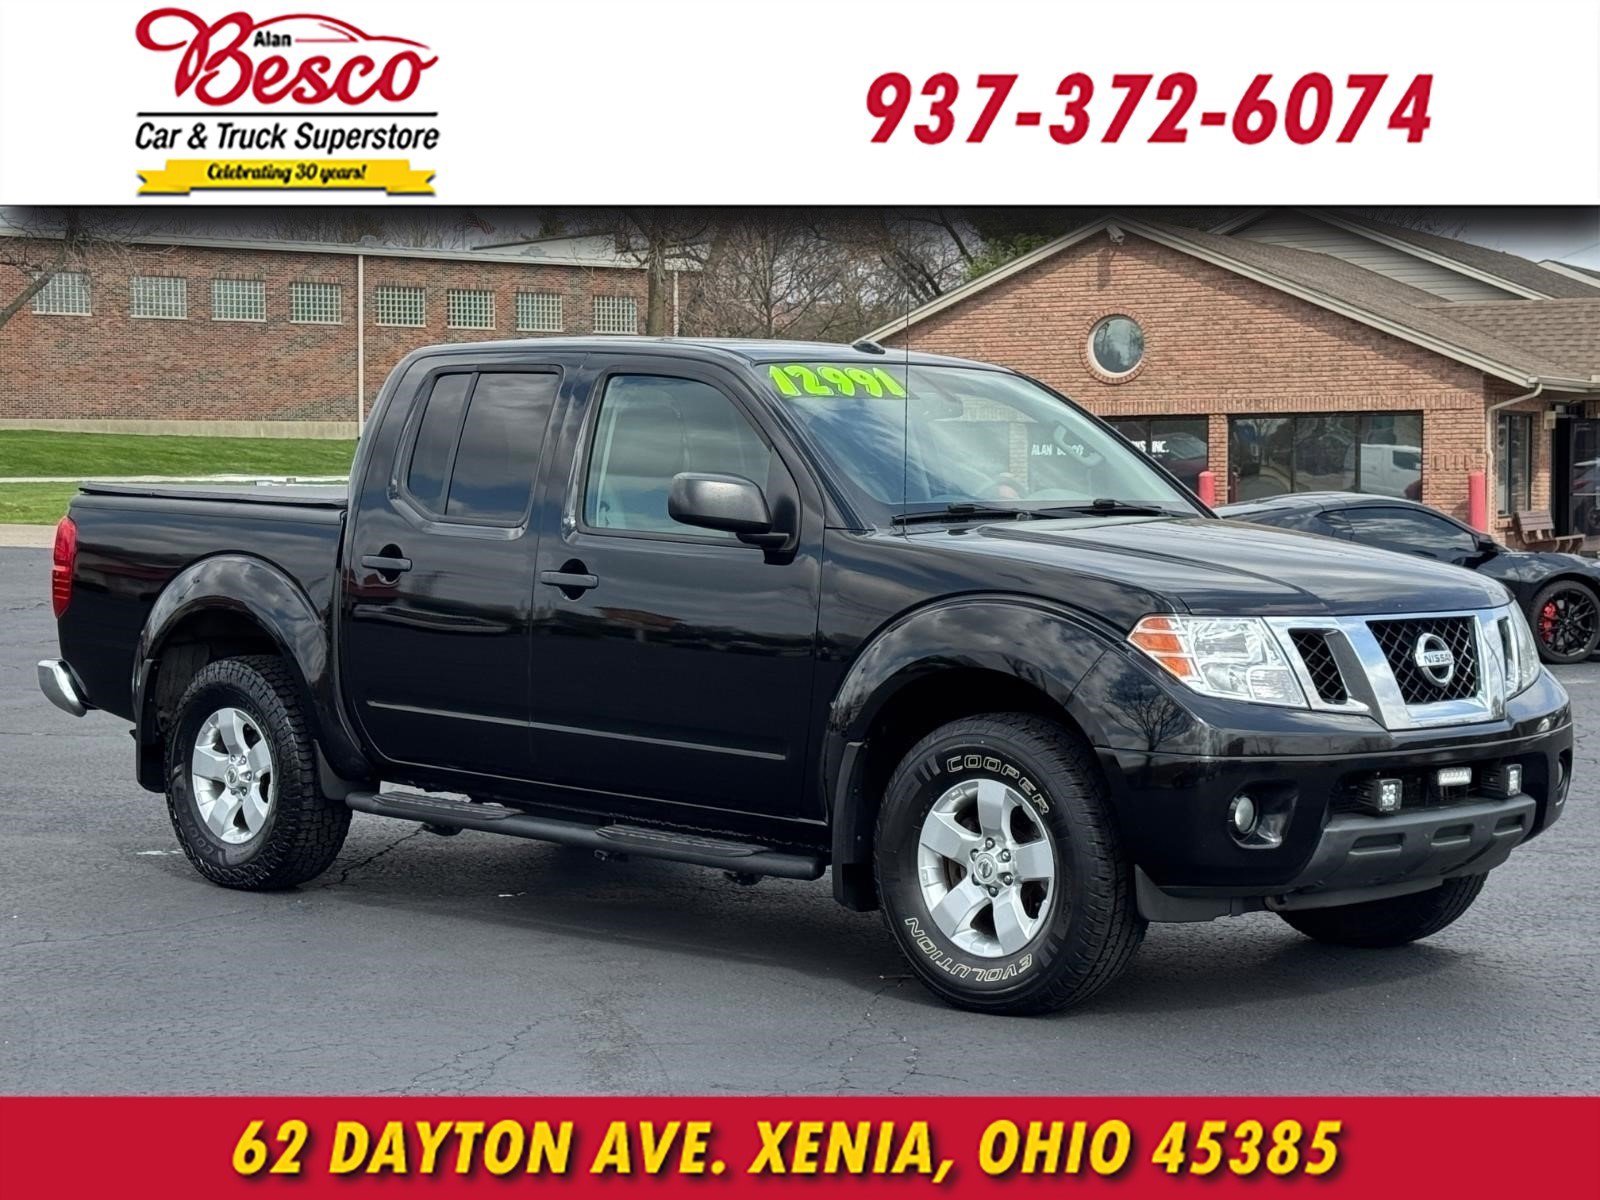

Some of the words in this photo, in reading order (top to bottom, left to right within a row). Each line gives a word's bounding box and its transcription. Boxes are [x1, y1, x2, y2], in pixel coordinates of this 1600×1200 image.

[769, 365, 907, 398] 12991
[1031, 444, 1052, 456] ALAN
[947, 755, 1049, 815] COOPER
[905, 917, 1033, 982] EVOLUTION
